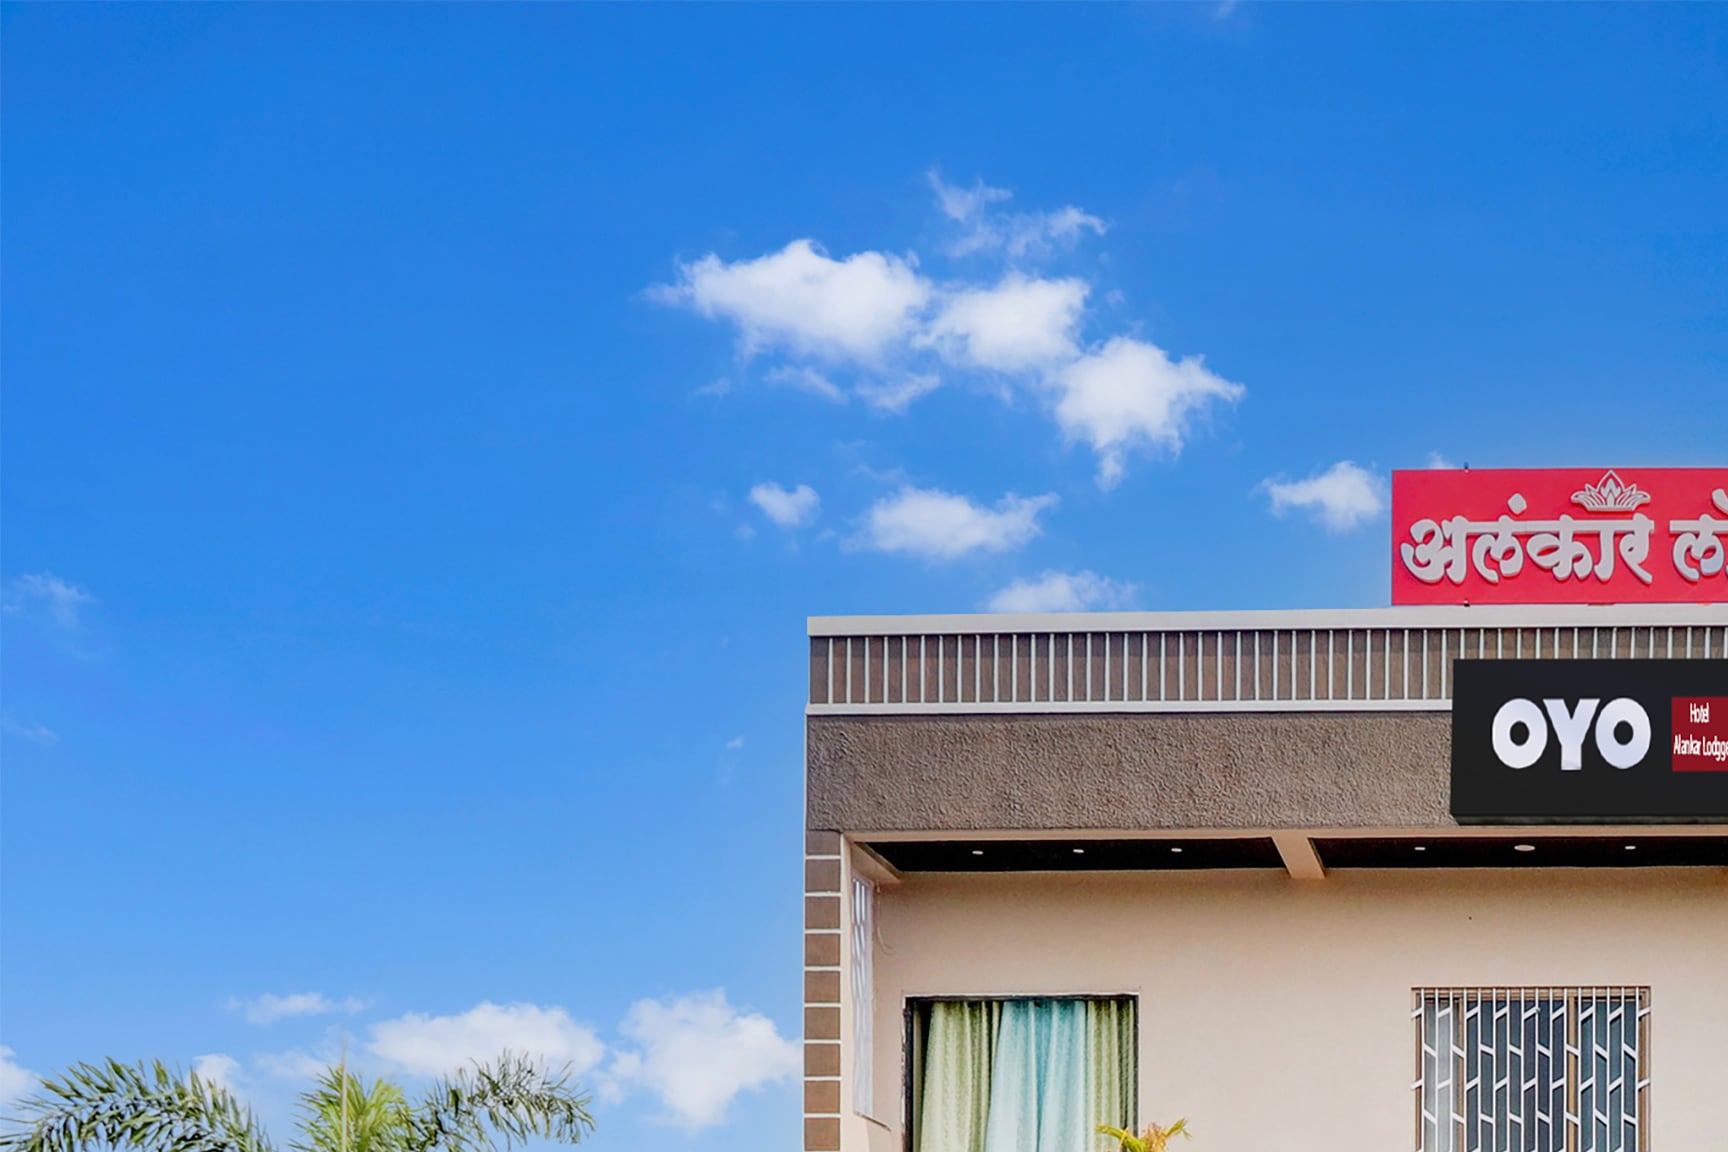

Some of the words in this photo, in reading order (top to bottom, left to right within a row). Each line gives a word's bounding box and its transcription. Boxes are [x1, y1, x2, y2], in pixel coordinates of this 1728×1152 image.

[1401, 493, 1655, 585] अलंकार
[1492, 698, 1652, 771] OYO
[1689, 702, 1710, 723] Hotel
[1673, 733, 1701, 755] Alankar
